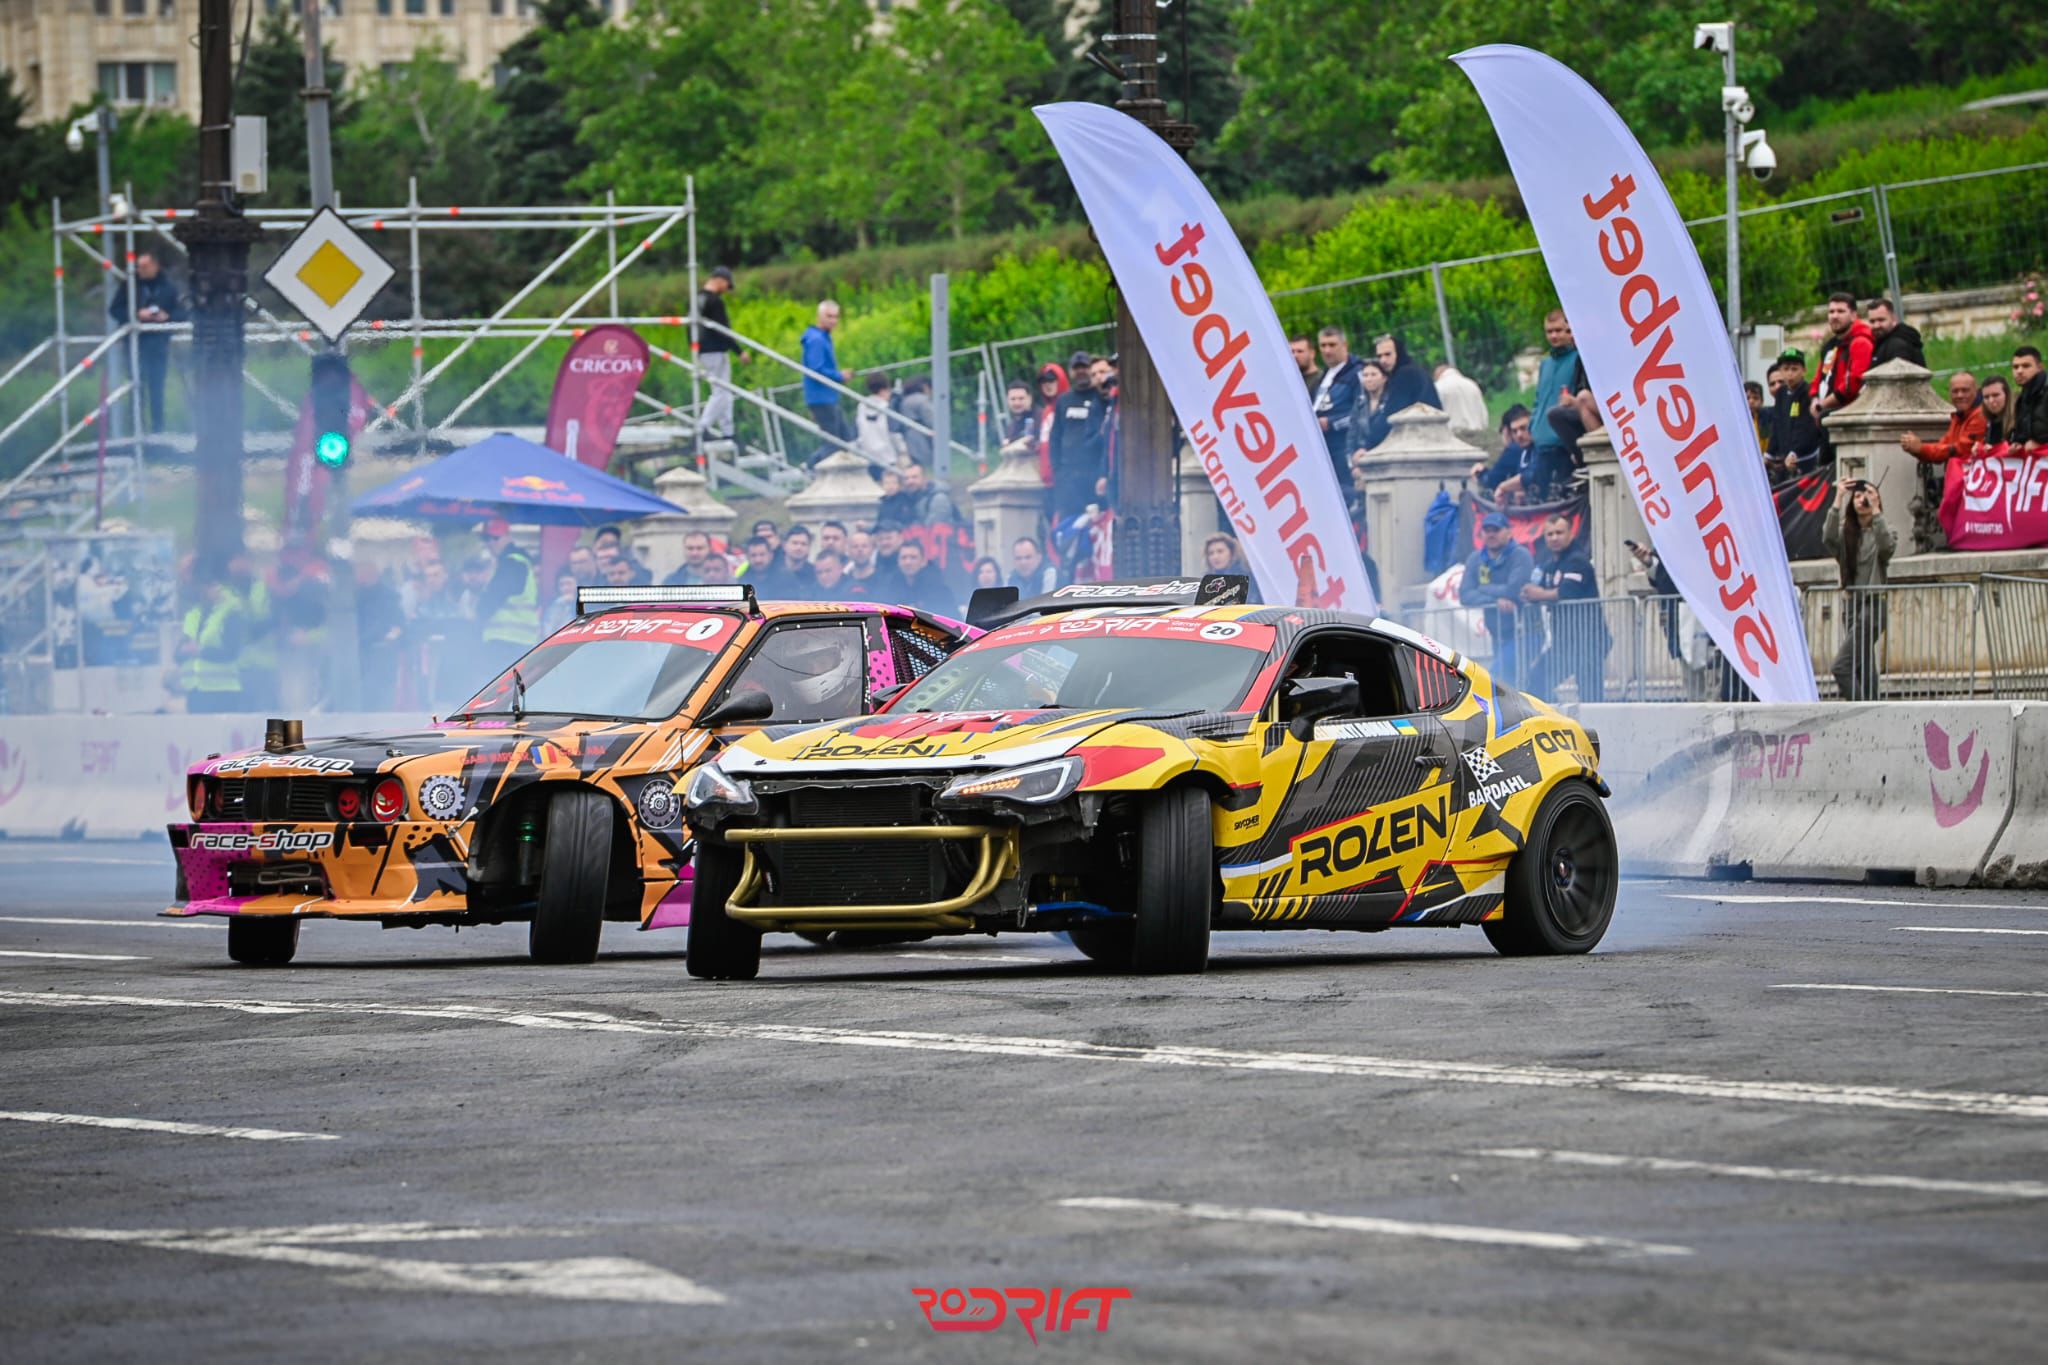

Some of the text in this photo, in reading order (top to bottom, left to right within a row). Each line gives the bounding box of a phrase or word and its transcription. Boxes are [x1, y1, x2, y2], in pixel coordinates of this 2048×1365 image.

[569, 358, 645, 373] CRICOVA
[1053, 581, 1200, 598] race-sho
[699, 624, 713, 635] 1
[1059, 618, 1169, 635] RODRIFT
[1206, 625, 1236, 636] 20
[1535, 729, 1577, 753] 007
[804, 744, 935, 760] ROLEN
[205, 755, 354, 776] race-shop
[1469, 774, 1532, 811] BARDAHL
[191, 829, 334, 851] race-shop
[1300, 797, 1448, 885] ROLEN
